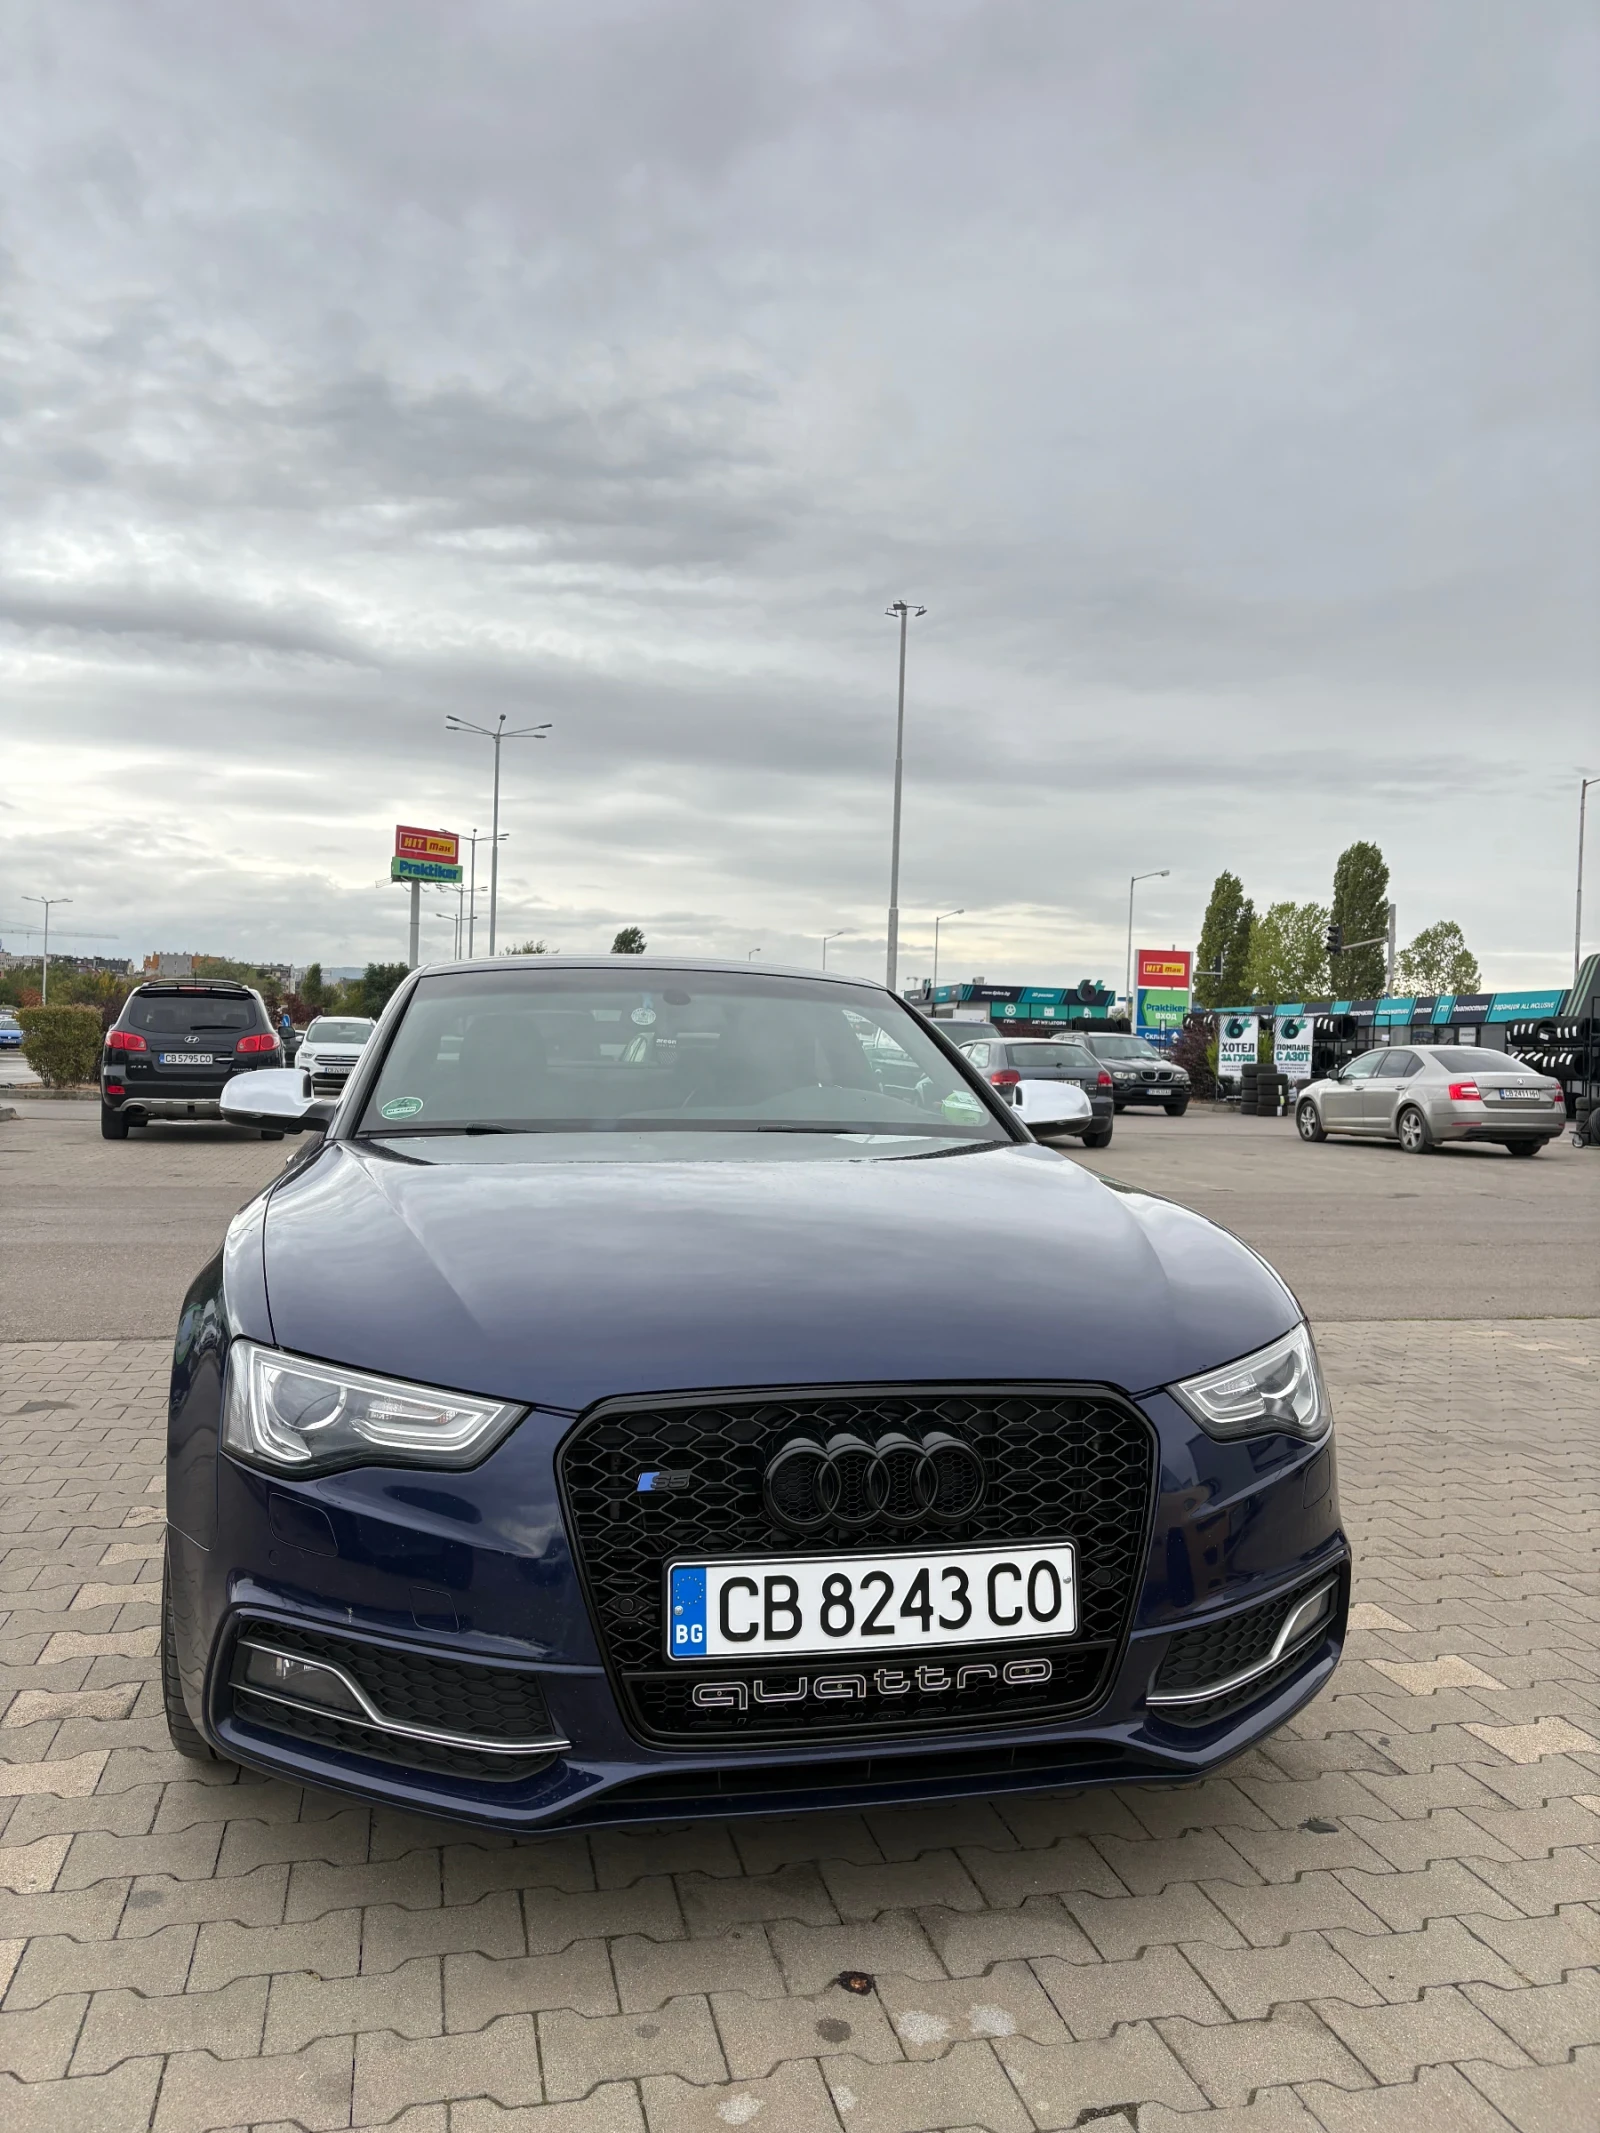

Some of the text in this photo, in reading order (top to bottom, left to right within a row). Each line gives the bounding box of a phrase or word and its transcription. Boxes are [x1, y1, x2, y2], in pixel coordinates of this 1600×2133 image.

[403, 837, 424, 848] HIT
[400, 860, 459, 879] Praktiker
[1146, 964, 1161, 972] HIT
[1146, 1003, 1186, 1013] Praktiker
[1155, 1012, 1177, 1021] ВХОД
[1221, 1043, 1255, 1053] ХОТЕЛ
[1276, 1043, 1310, 1052] ПОМПАНЕ
[165, 1054, 211, 1063] CB 5795 CO
[1221, 1053, 1255, 1062] ЗА ГУМИ
[1276, 1051, 1310, 1062] С АЗОТ
[651, 1474, 690, 1489] S5
[720, 1559, 1062, 1642] CB 8243 CO
[675, 1623, 703, 1644] BG
[692, 1658, 1052, 1711] quattro
